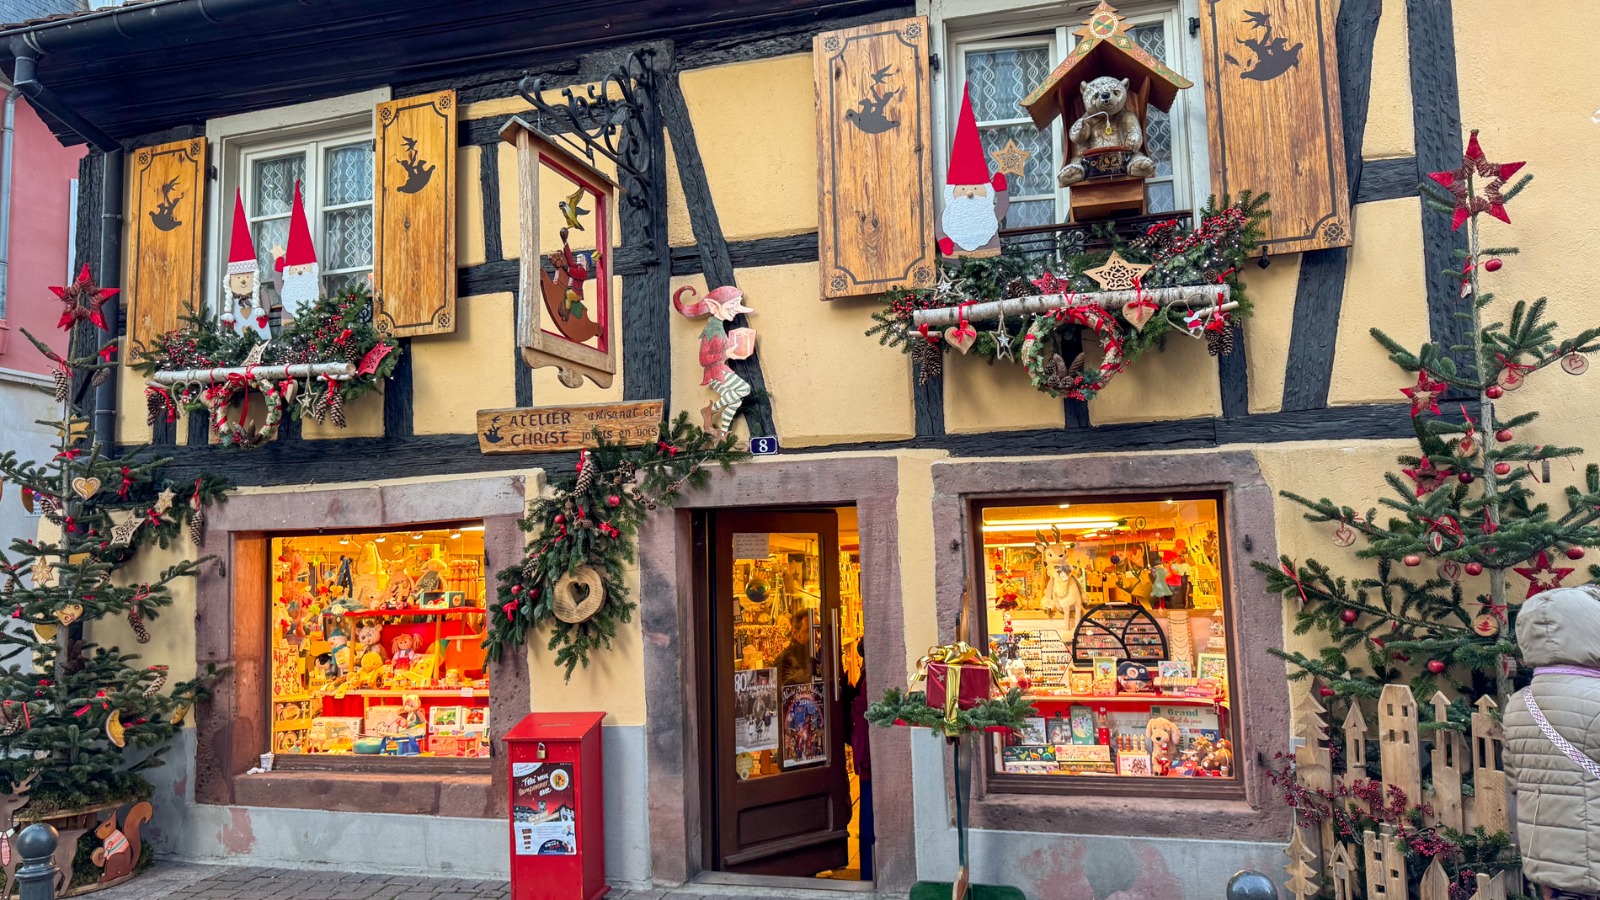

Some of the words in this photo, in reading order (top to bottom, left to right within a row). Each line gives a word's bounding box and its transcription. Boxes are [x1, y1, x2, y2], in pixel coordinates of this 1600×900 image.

[509, 412, 571, 427] ATELIER
[588, 407, 639, 420] artisanat
[643, 405, 655, 417] et
[511, 431, 568, 446] CHRIST
[619, 429, 631, 438] en
[759, 439, 768, 453] 8
[734, 673, 747, 691] 80
[1167, 708, 1199, 717] Grand
